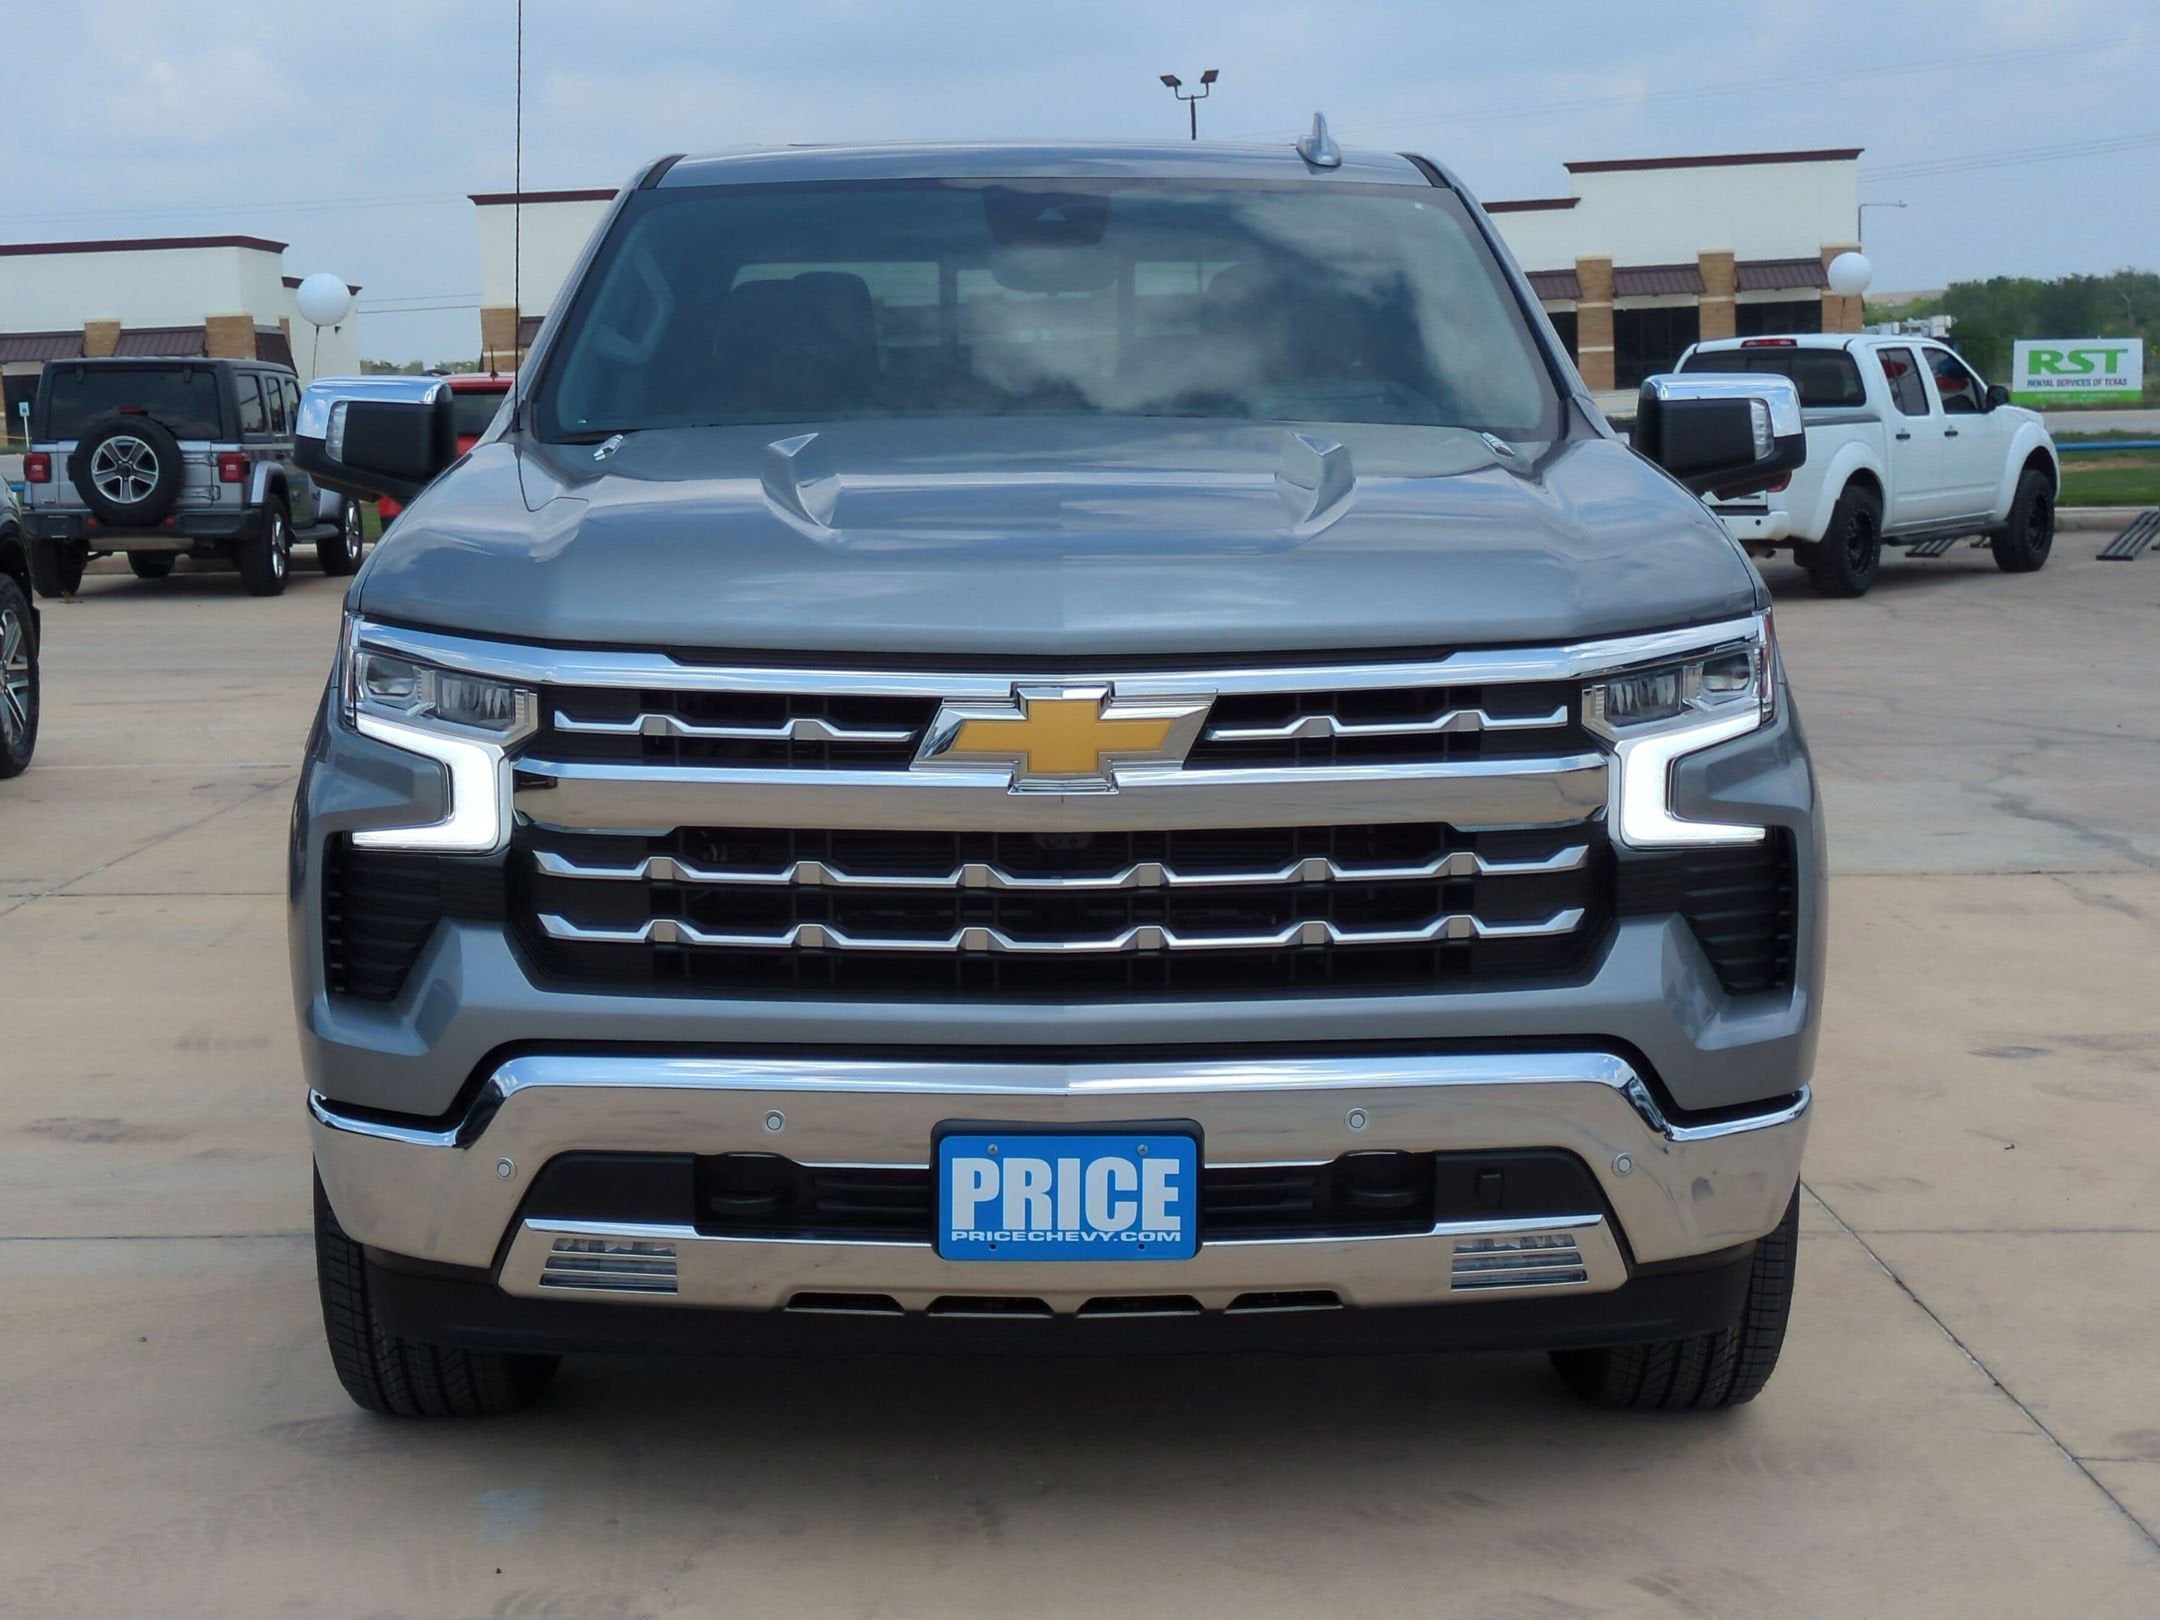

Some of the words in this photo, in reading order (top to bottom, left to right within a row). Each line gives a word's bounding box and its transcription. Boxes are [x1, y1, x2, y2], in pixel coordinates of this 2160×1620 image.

[2028, 348, 2128, 375] RST
[2027, 379, 2054, 387] RENTAL
[2056, 378, 2091, 387] SERVICES
[2093, 378, 2103, 386] OF
[2104, 378, 2127, 386] TEXAS
[951, 1157, 1181, 1231] PRICE
[951, 1230, 1181, 1241] PRICECHEVY.COM
